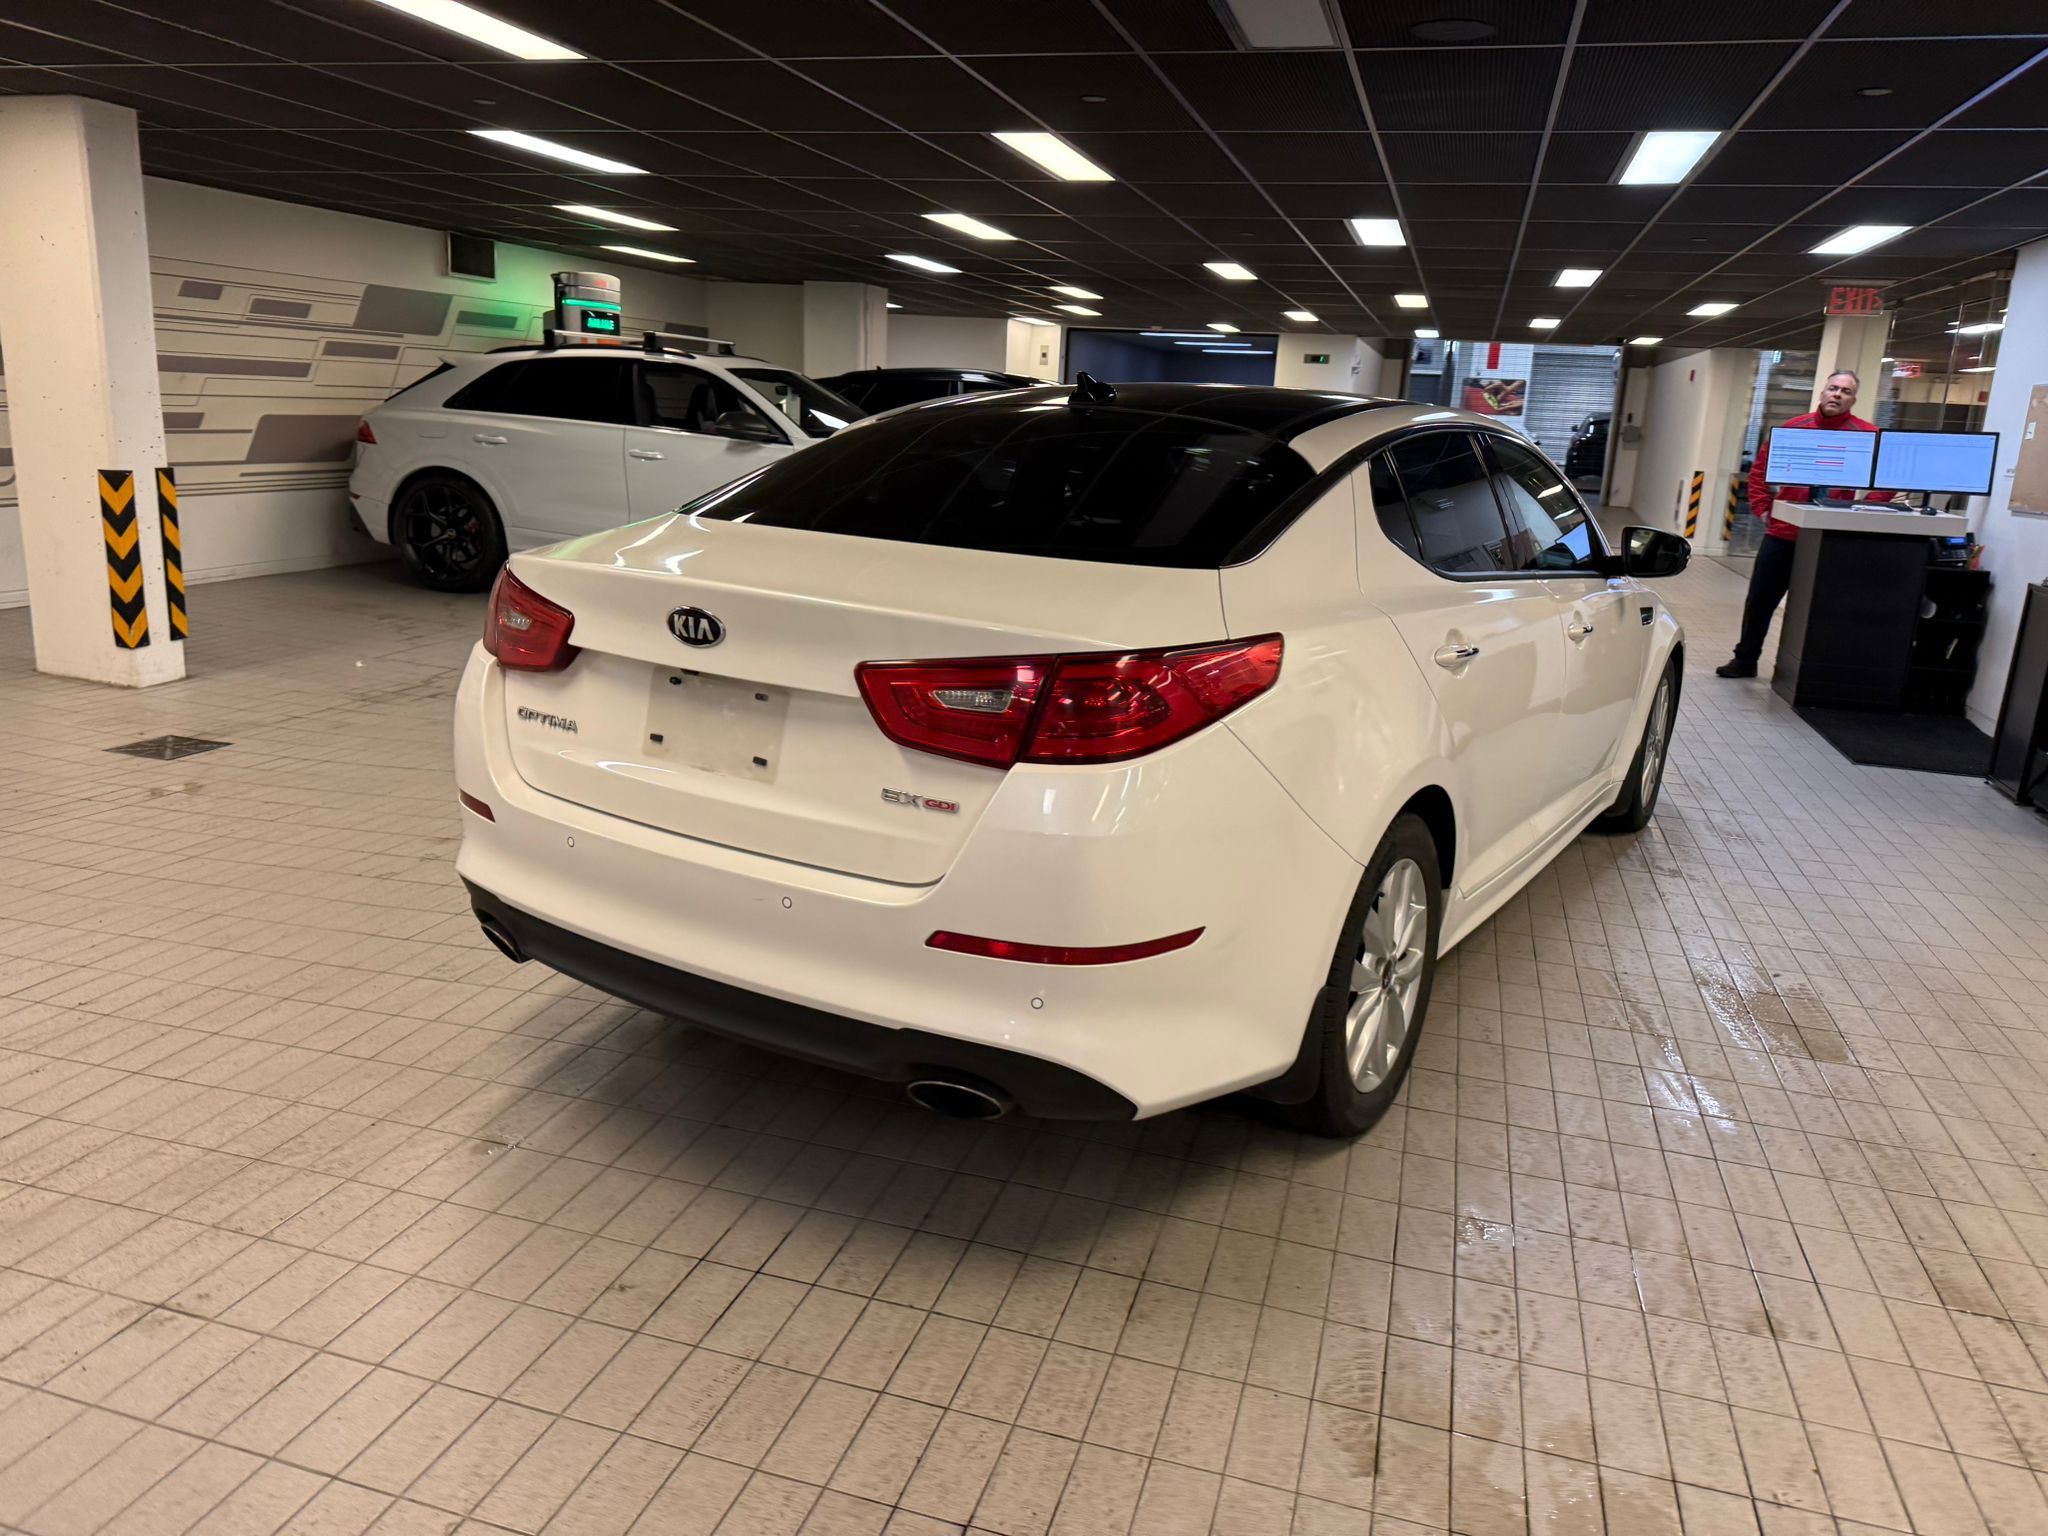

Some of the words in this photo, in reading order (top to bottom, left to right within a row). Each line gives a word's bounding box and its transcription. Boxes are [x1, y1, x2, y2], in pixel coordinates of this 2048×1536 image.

[1829, 287, 1878, 314] EXIT
[673, 613, 715, 641] KIA
[517, 705, 578, 733] OPTIMA
[881, 788, 922, 808] EX
